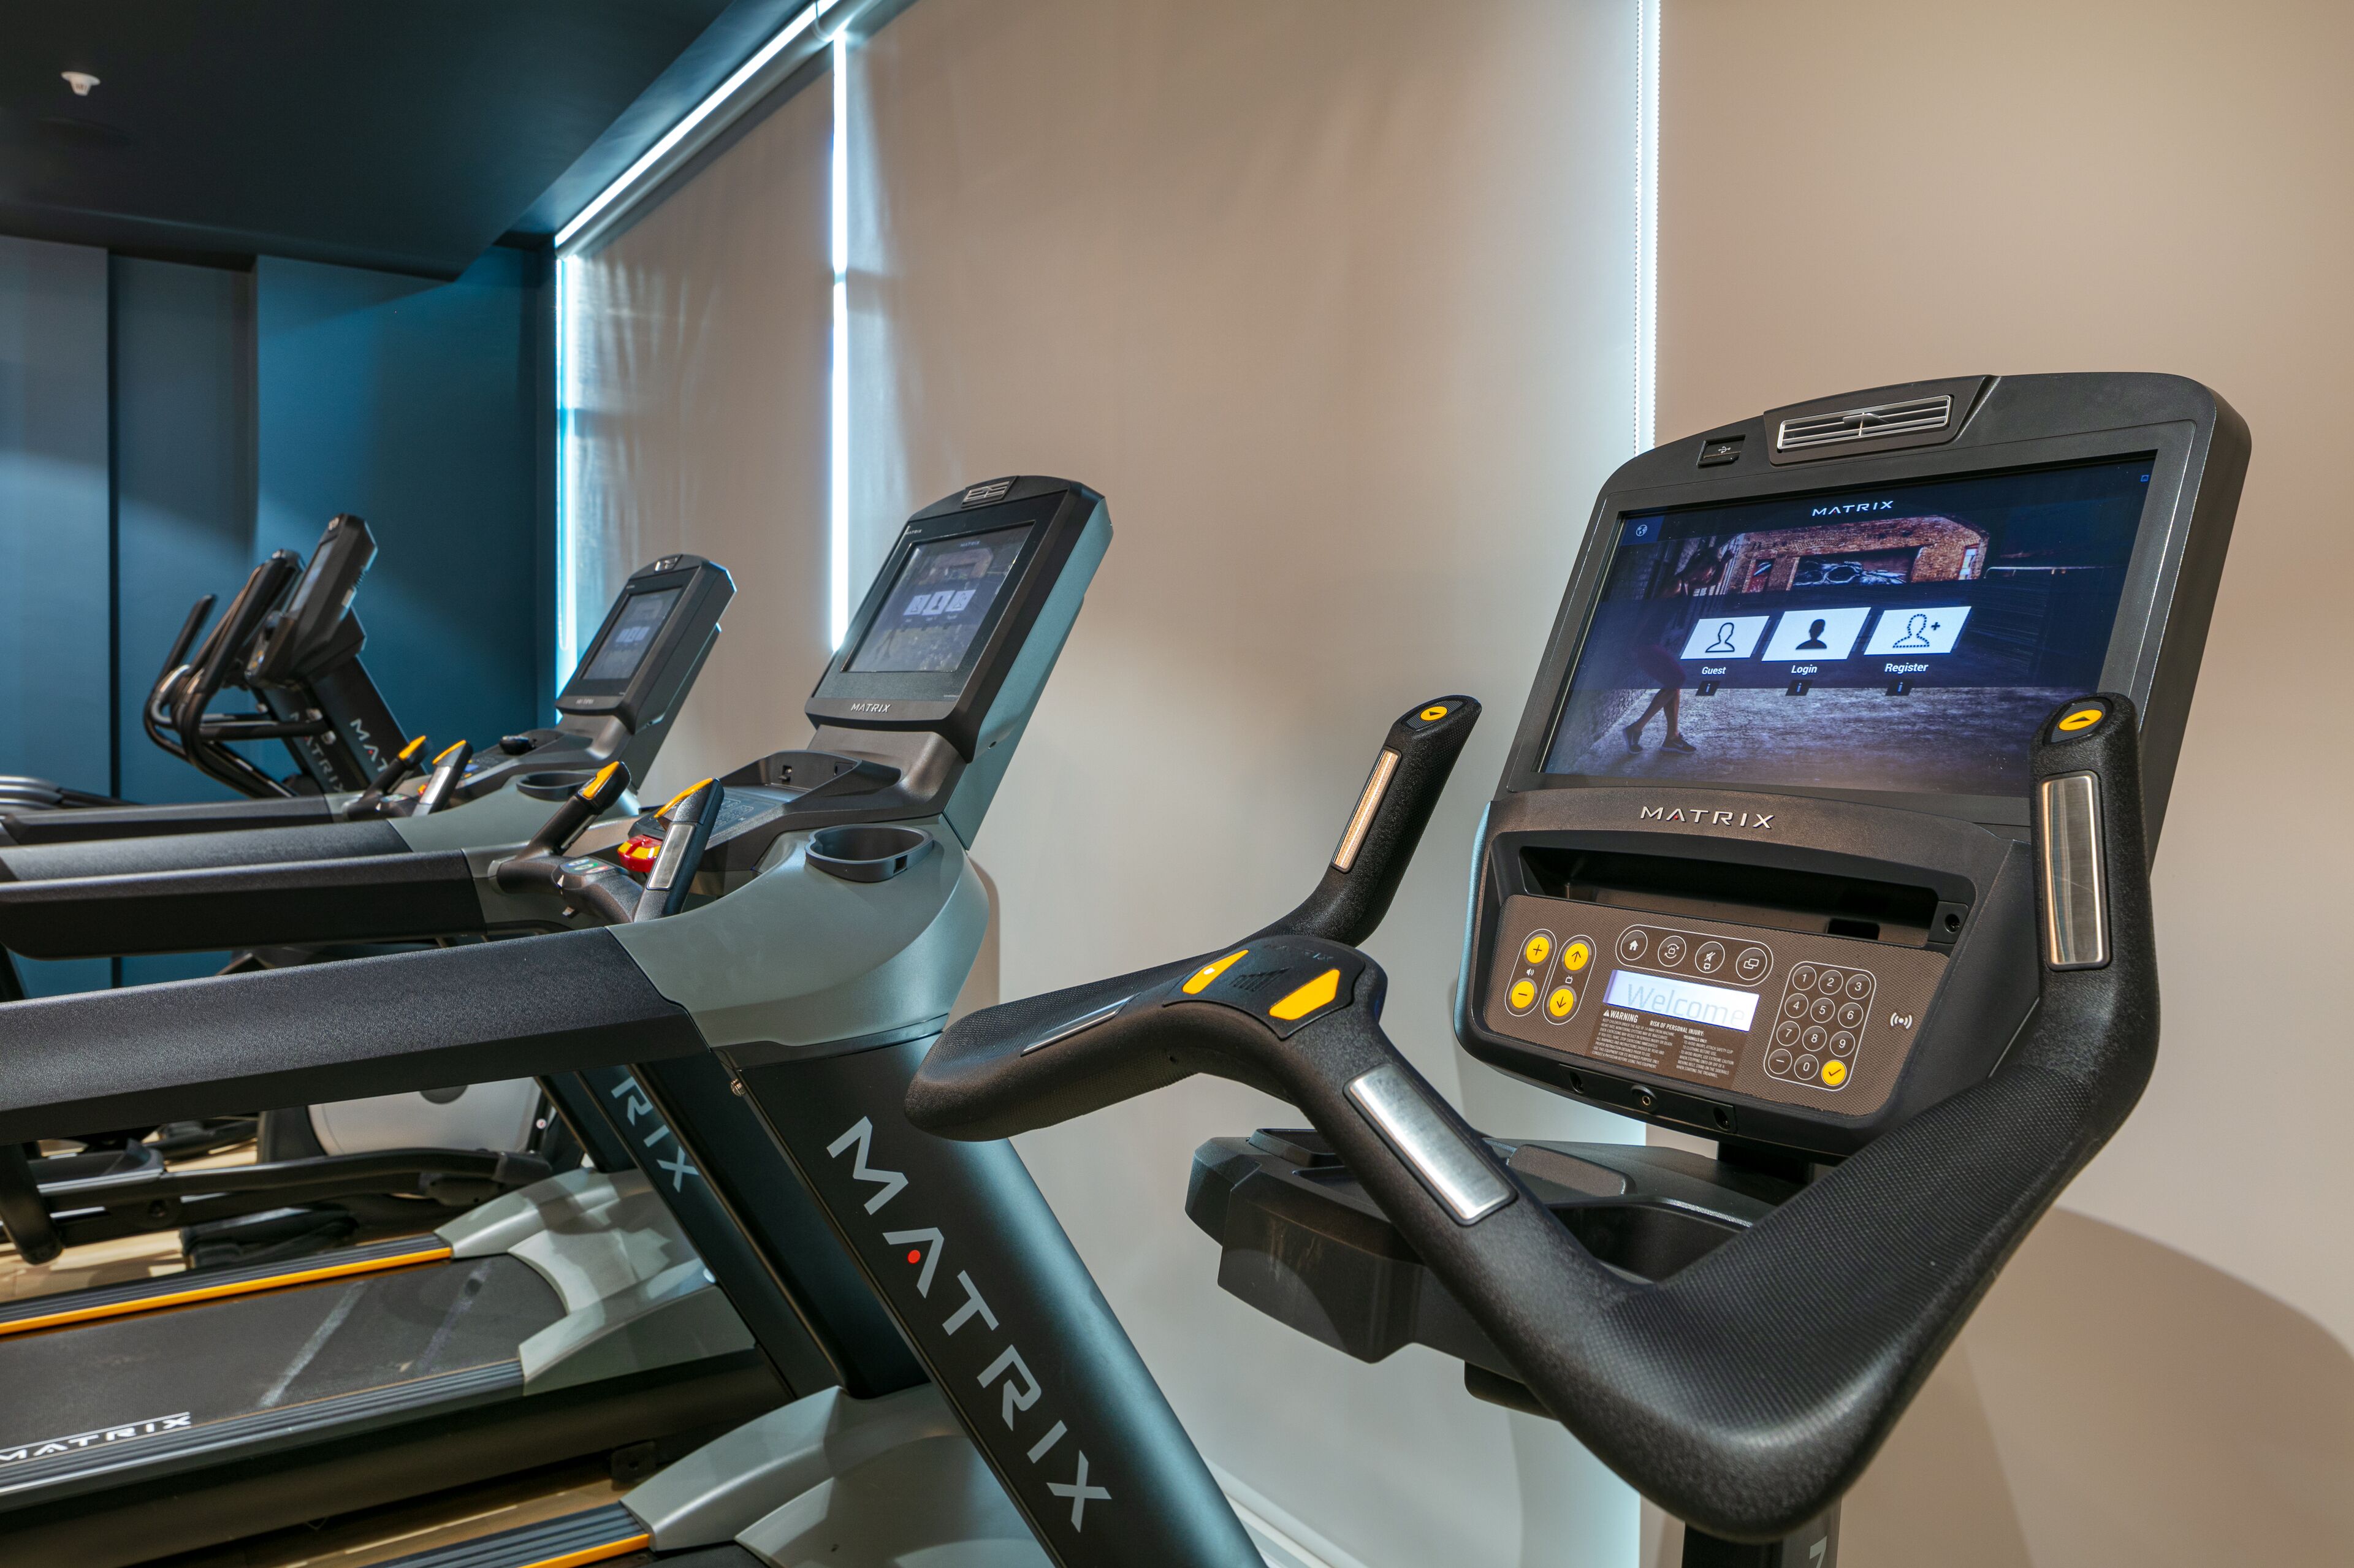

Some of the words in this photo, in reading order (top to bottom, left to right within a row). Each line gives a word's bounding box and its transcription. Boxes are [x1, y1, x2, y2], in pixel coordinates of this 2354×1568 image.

[1812, 501, 1894, 516] MATRIX
[1702, 666, 1726, 675] Guest
[1791, 664, 1818, 675] Login
[1884, 663, 1929, 674] Register
[851, 703, 891, 713] MATRIX
[1640, 806, 1774, 829] MATRIX
[1803, 973, 1807, 982] 1
[1827, 978, 1835, 987] 2
[1854, 982, 1862, 991] 3
[1628, 984, 1745, 1028] Welcome
[1793, 1001, 1799, 1010] 4
[1819, 1005, 1826, 1014] 5
[1847, 1010, 1854, 1020] 6
[1610, 1010, 1639, 1023] WARNING
[1666, 1023, 1688, 1033] PERSONAL
[1785, 1029, 1792, 1037] 7
[1811, 1033, 1818, 1043] 8
[1838, 1039, 1846, 1048] 9
[1803, 1062, 1810, 1071] 0
[611, 1077, 700, 1193] RIX
[826, 1116, 1112, 1533] MATRIX
[0, 1415, 191, 1461] MATRIX
